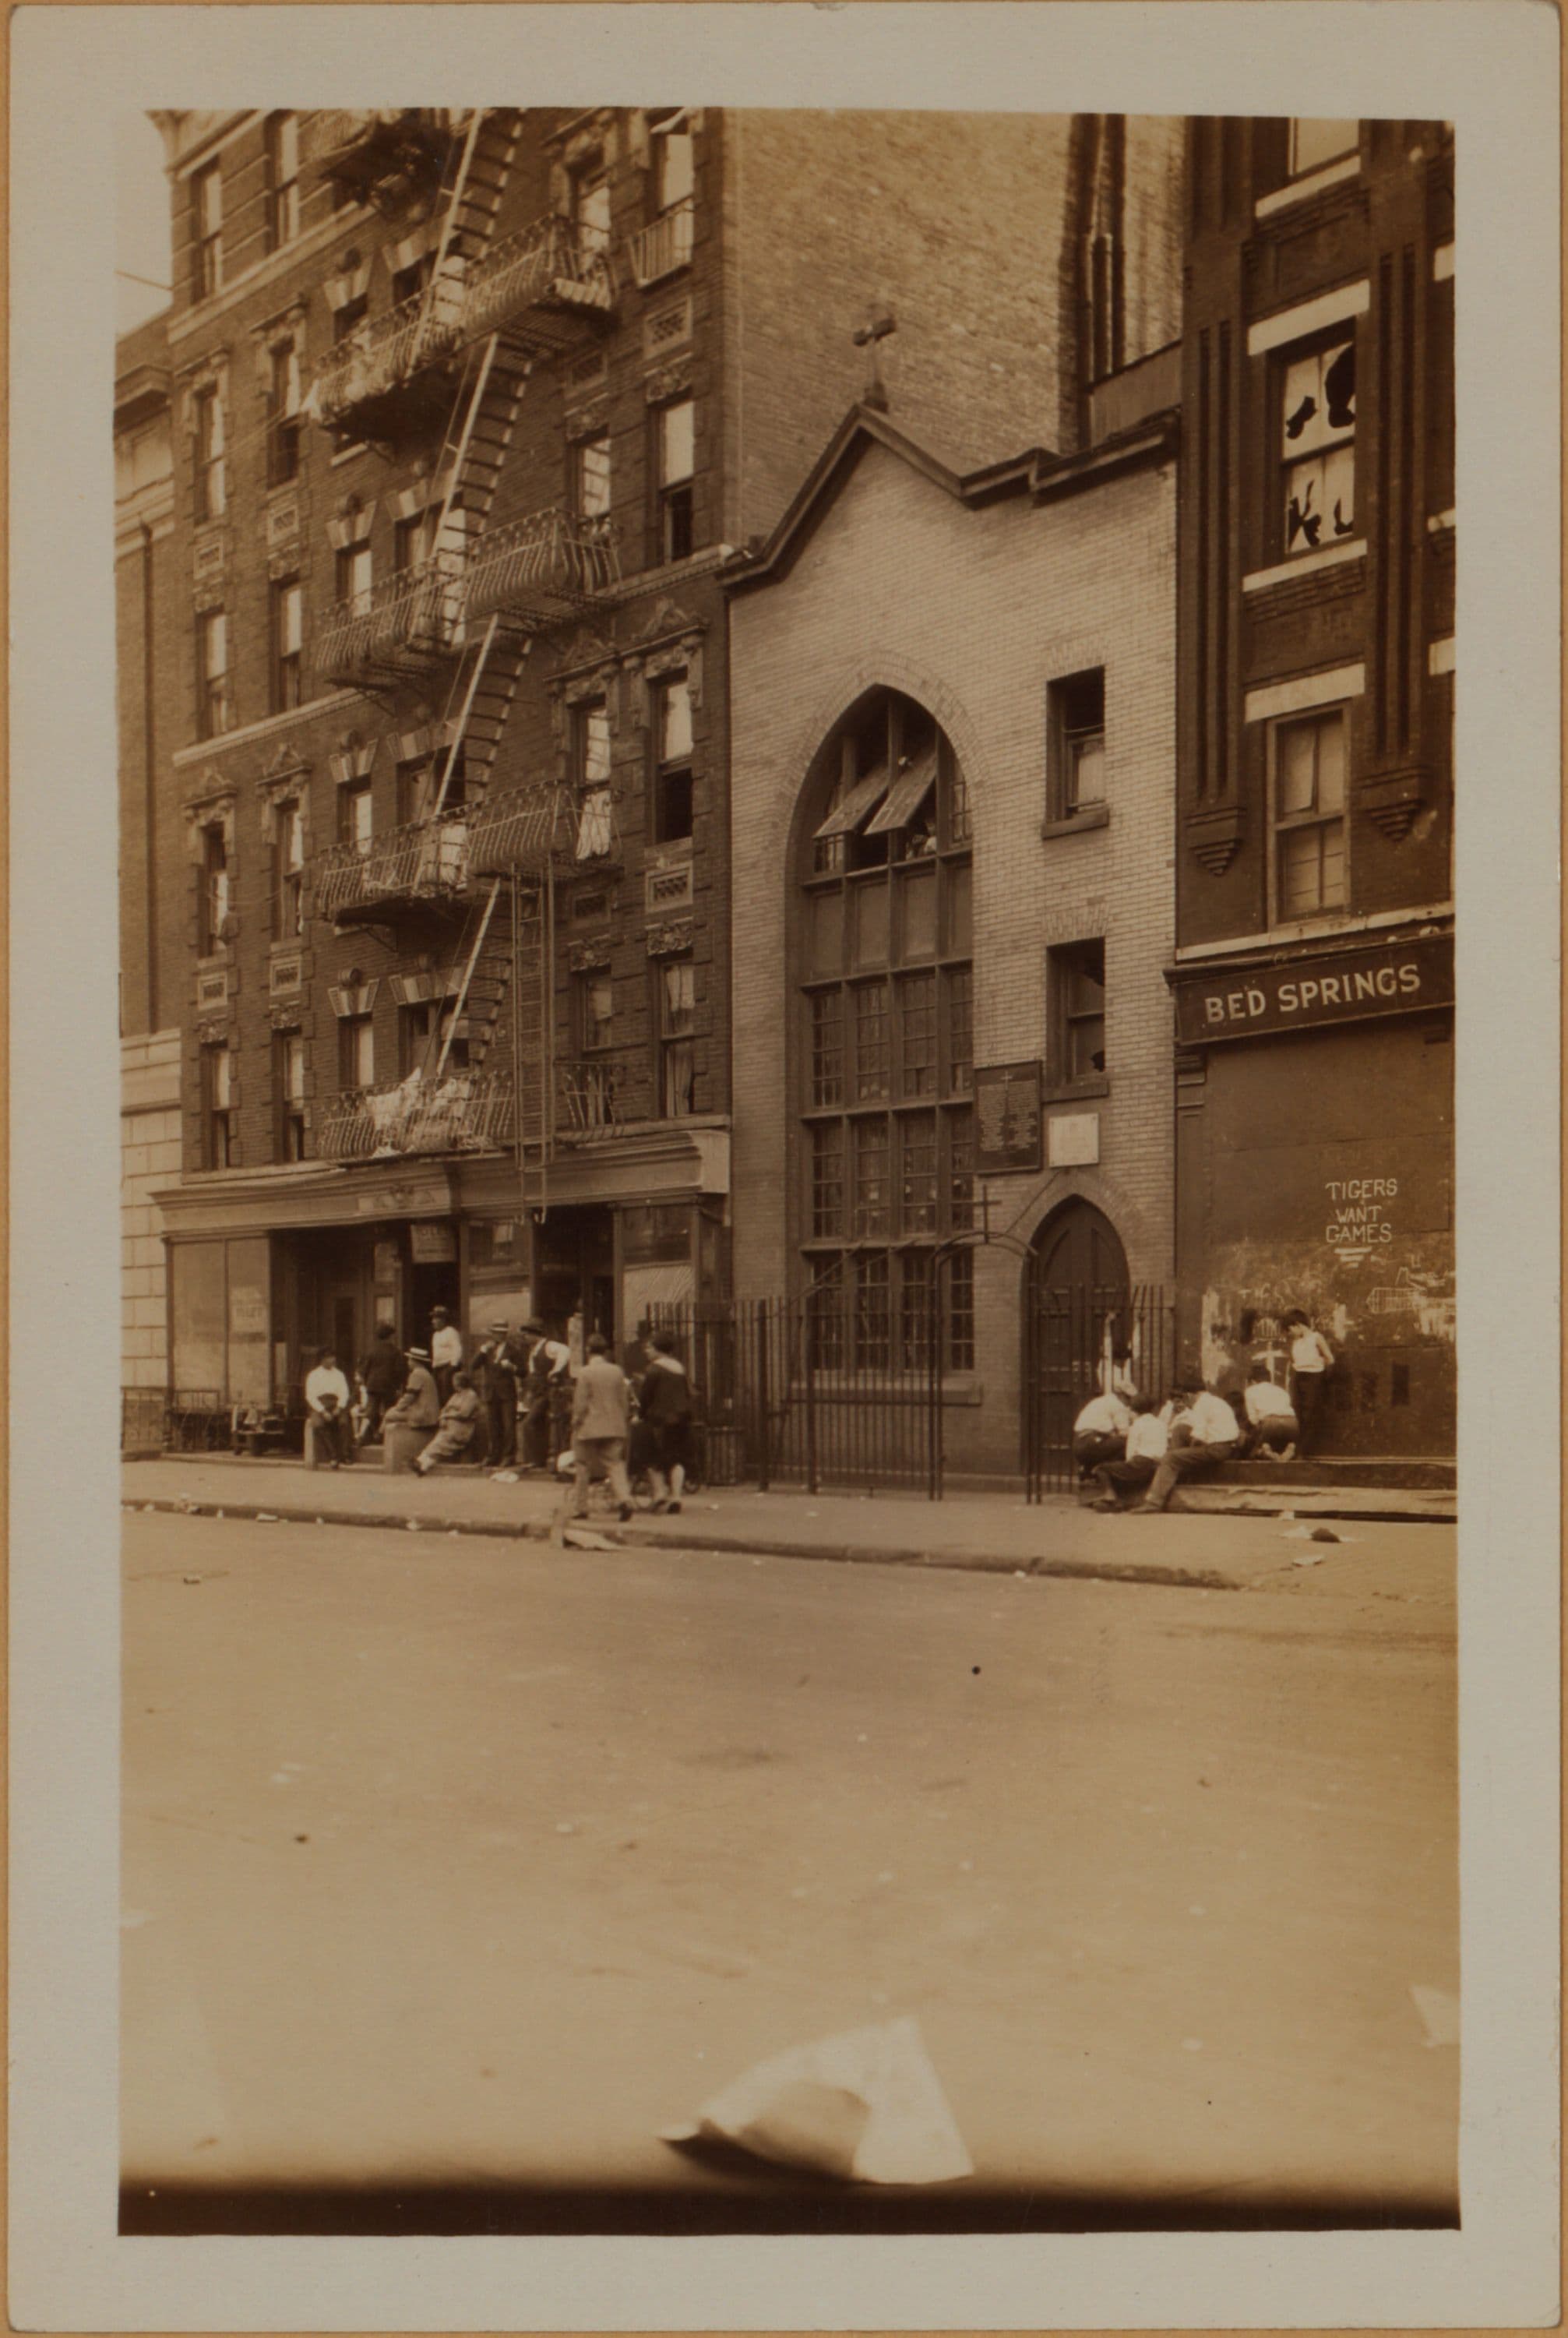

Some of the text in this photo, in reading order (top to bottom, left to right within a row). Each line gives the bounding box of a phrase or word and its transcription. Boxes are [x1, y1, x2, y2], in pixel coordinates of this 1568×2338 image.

[1205, 964, 1421, 1023] BED SPRINGS
[1325, 1178, 1397, 1201] TIGERS
[1336, 1205, 1382, 1224] WANT
[1326, 1223, 1392, 1243] GAMES
